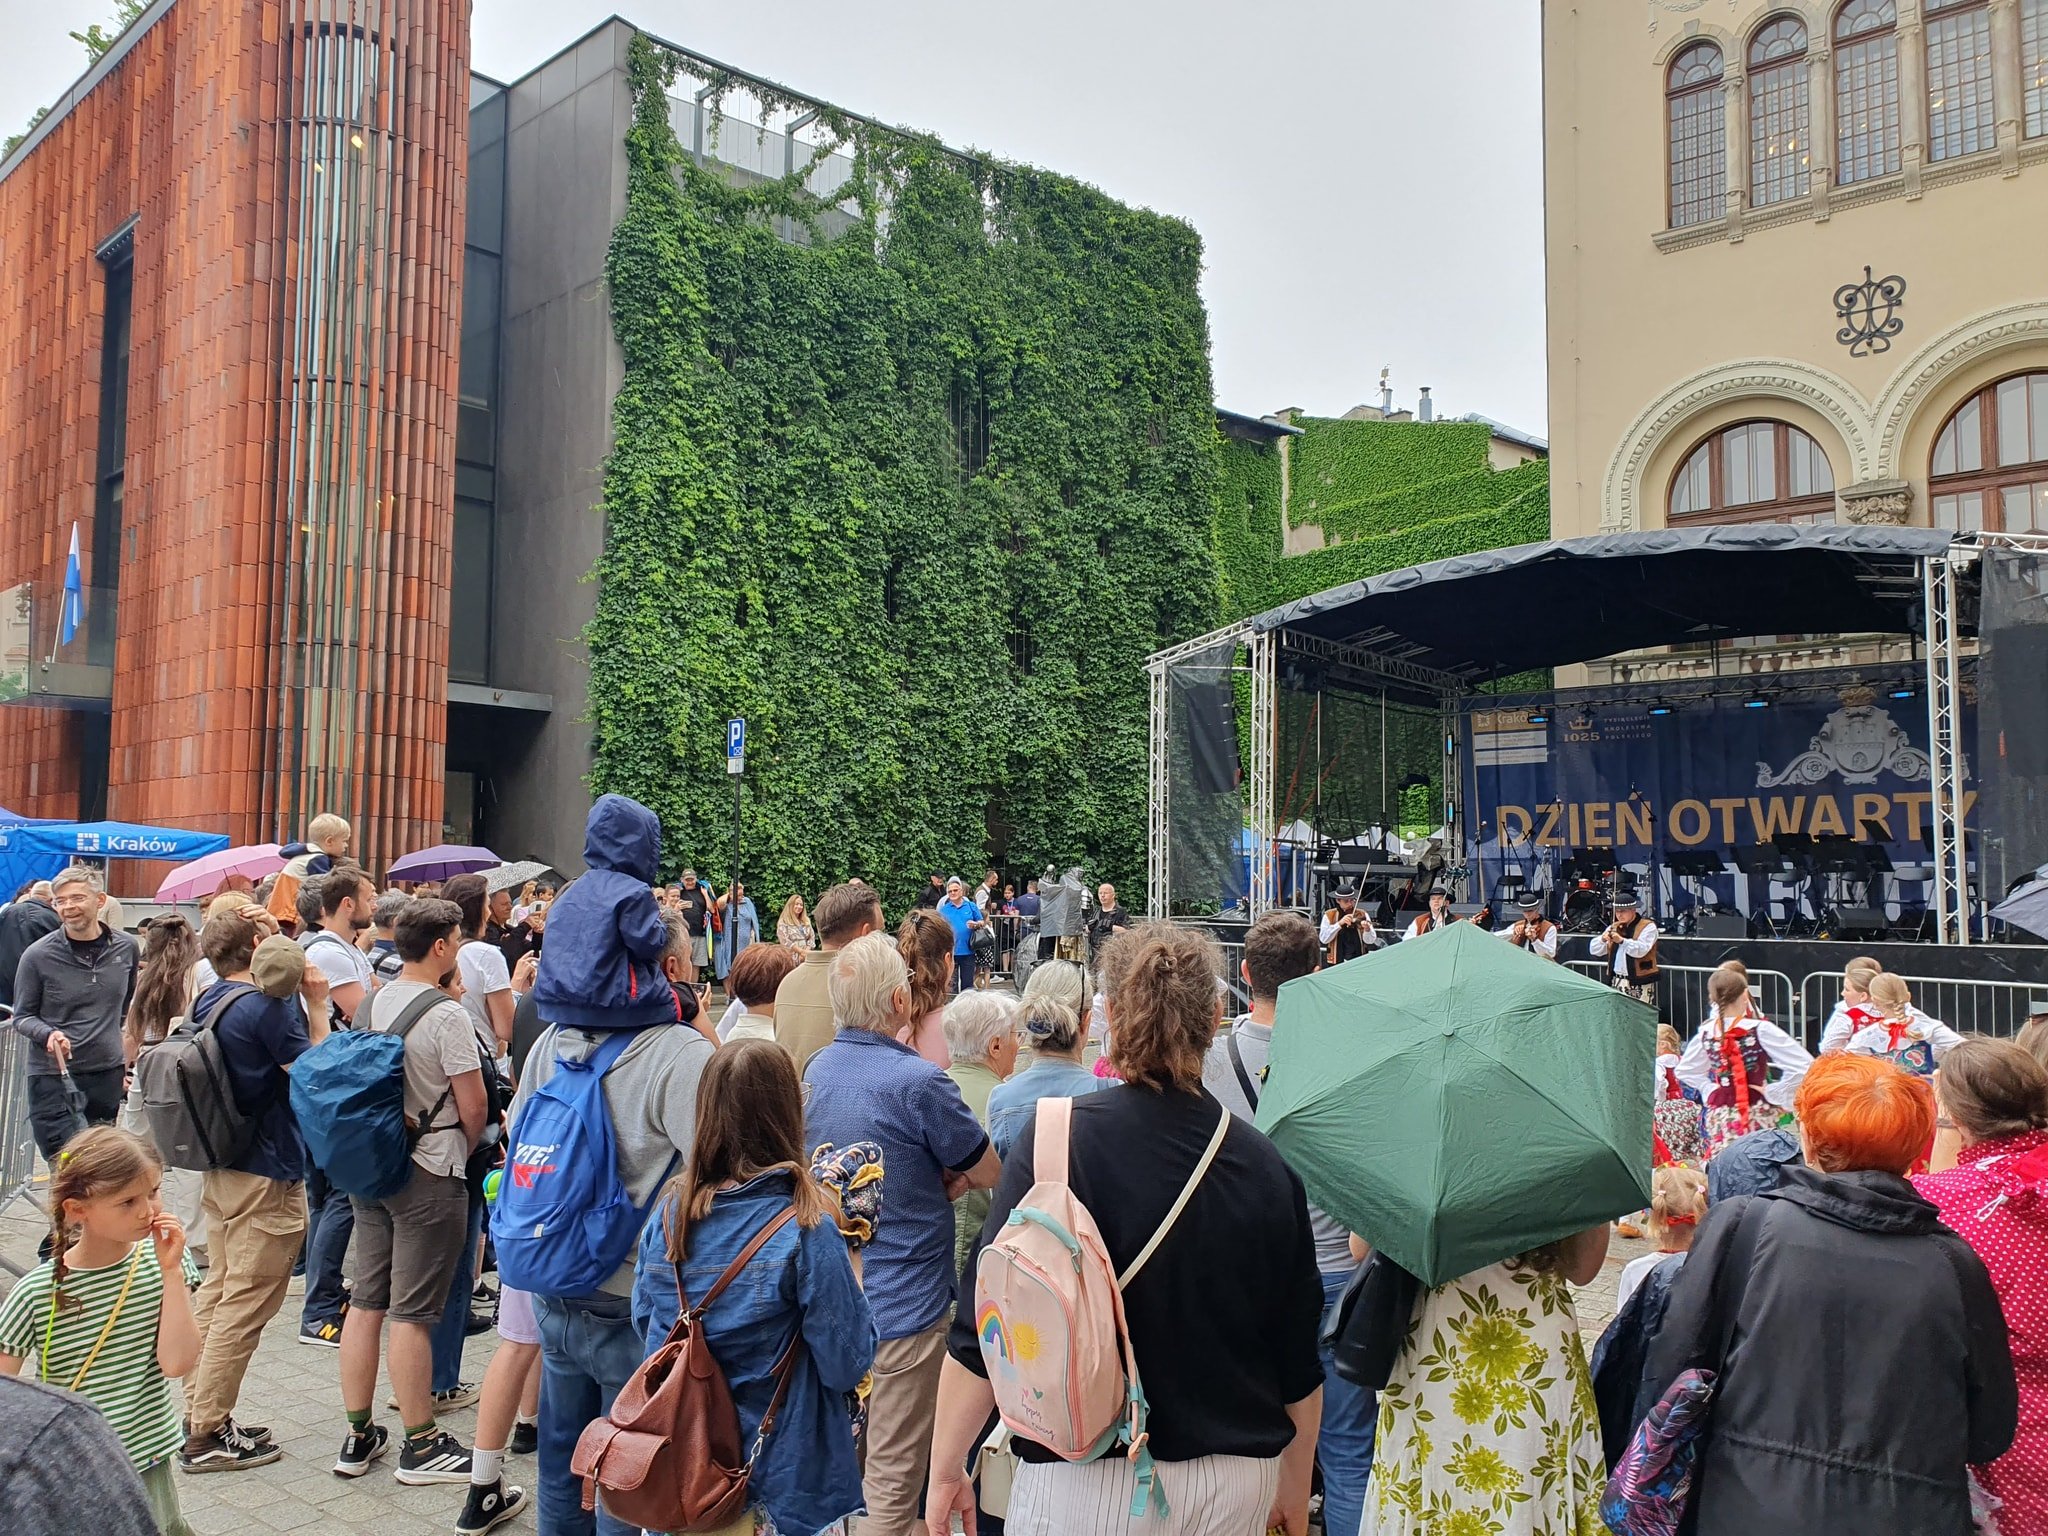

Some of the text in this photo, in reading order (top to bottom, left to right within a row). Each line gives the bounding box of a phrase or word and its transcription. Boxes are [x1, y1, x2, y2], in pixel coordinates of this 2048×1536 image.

[731, 723, 741, 747] P
[1563, 732, 1600, 743] 1025
[1496, 791, 1653, 847] DZIEŃ
[107, 836, 177, 852] Kraków
